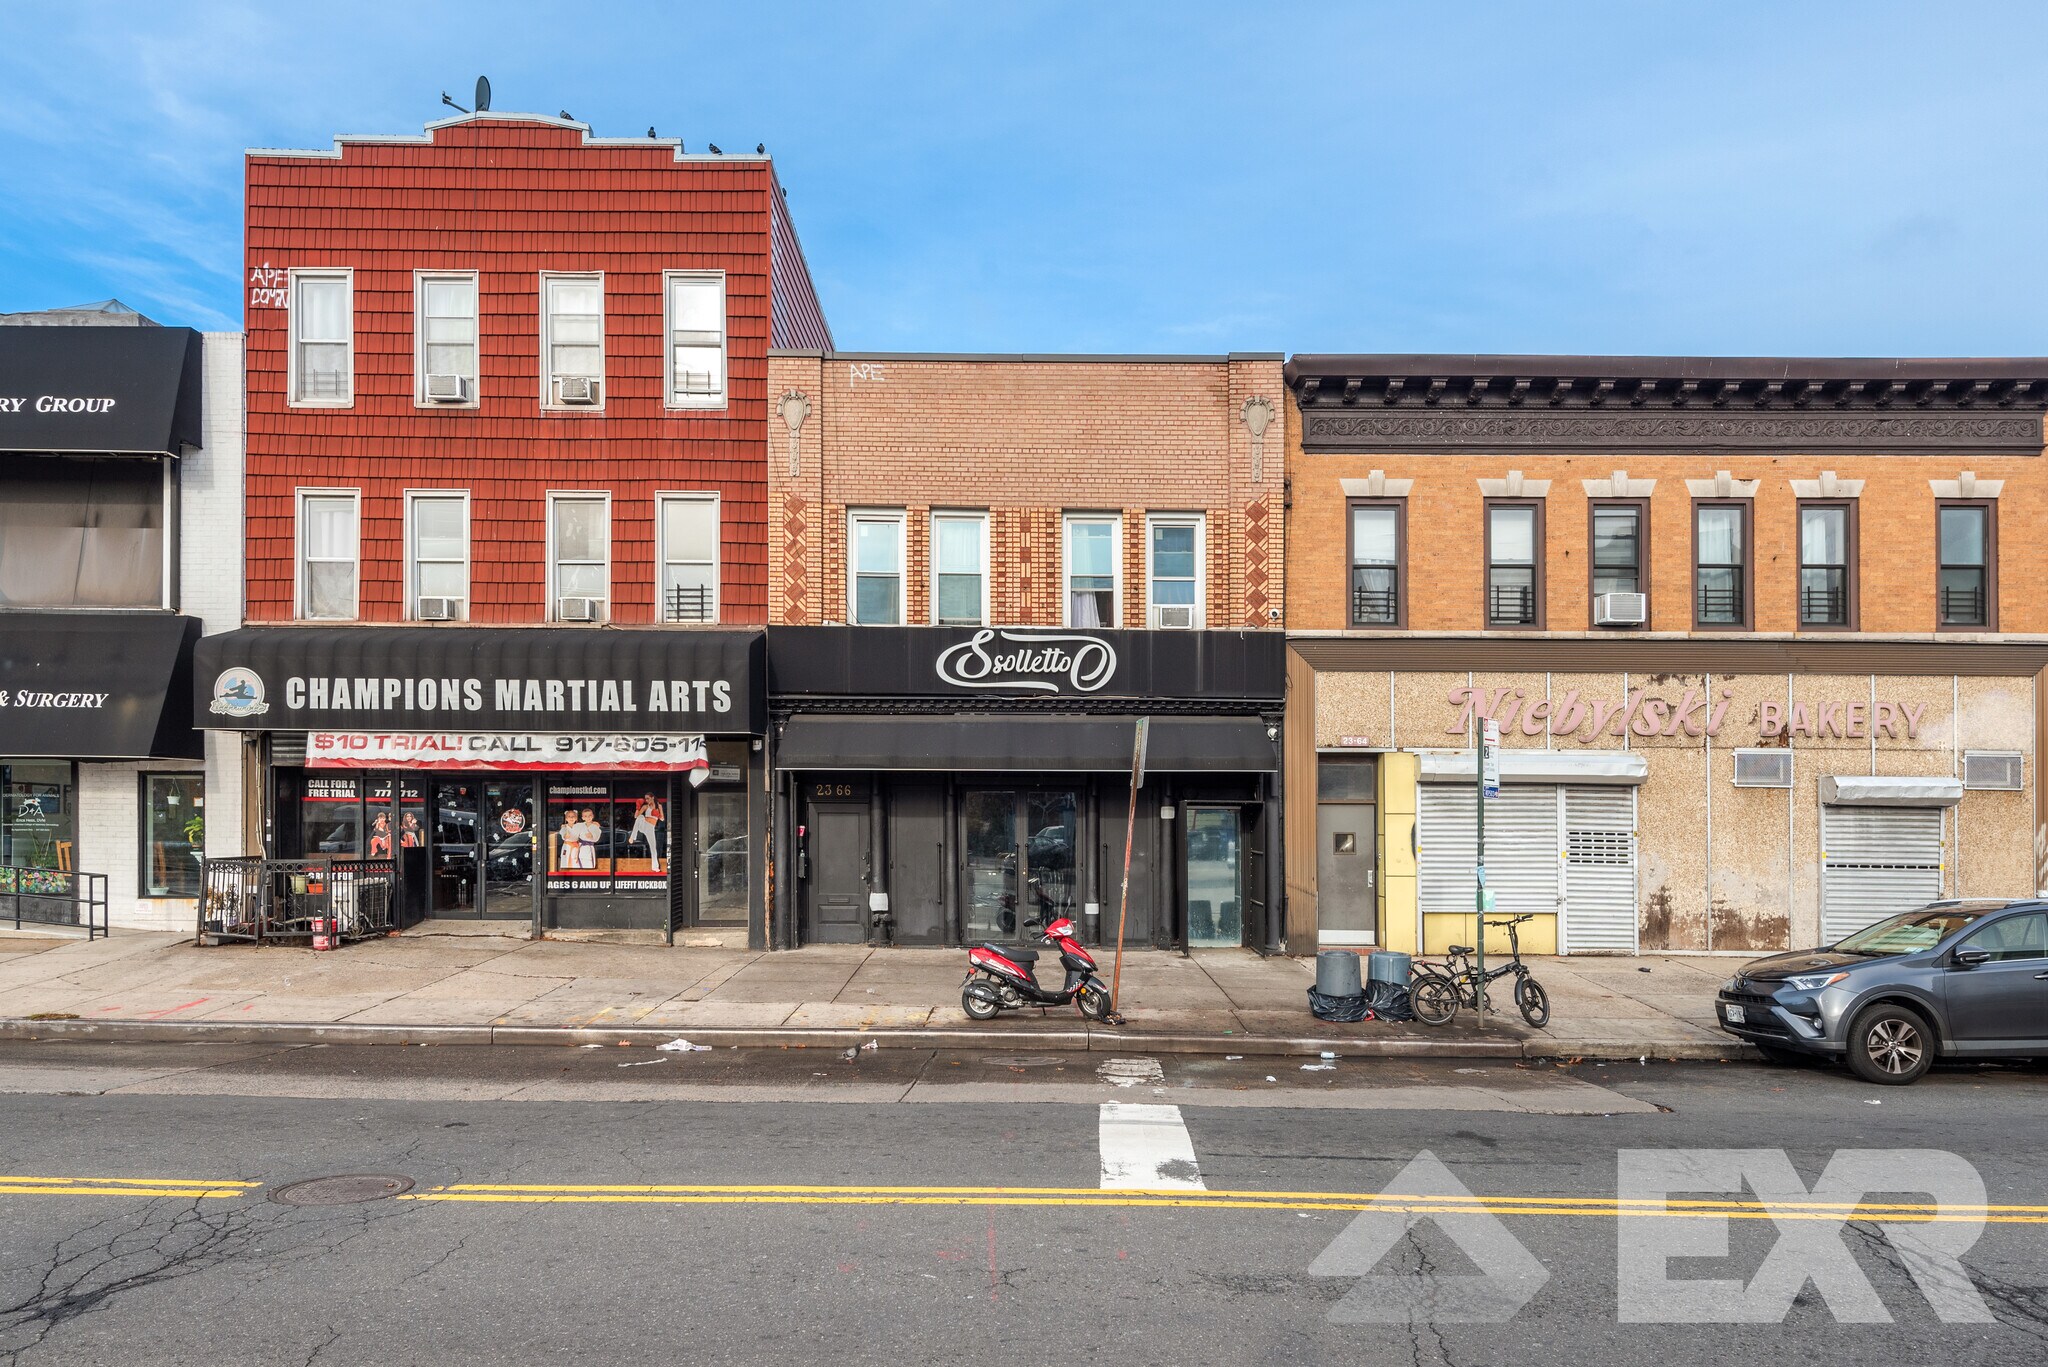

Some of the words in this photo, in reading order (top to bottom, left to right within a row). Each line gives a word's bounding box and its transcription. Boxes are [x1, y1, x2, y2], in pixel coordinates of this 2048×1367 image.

[850, 363, 885, 388] APE
[35, 395, 116, 413] GROUP
[13, 689, 109, 708] SURGERY
[285, 676, 482, 712] CHAMPIONS
[495, 678, 637, 712] MARTIAL
[648, 680, 732, 713] ARTS
[1445, 687, 1733, 743] Niebylski
[1759, 701, 1928, 739] BAKERY
[314, 732, 368, 751] $10
[373, 734, 463, 752] TRIAL!
[468, 735, 542, 752] CALL
[308, 779, 329, 788] CALL
[330, 780, 348, 788] FOR
[349, 780, 356, 789] A
[549, 786, 607, 795] championstkd.com
[308, 789, 329, 797] FREE
[329, 789, 356, 798] TRIAL
[547, 881, 571, 889] AGES
[571, 881, 578, 889] 6
[579, 881, 598, 889] AND
[600, 881, 612, 889] UP
[637, 881, 667, 889] KICKBOX
